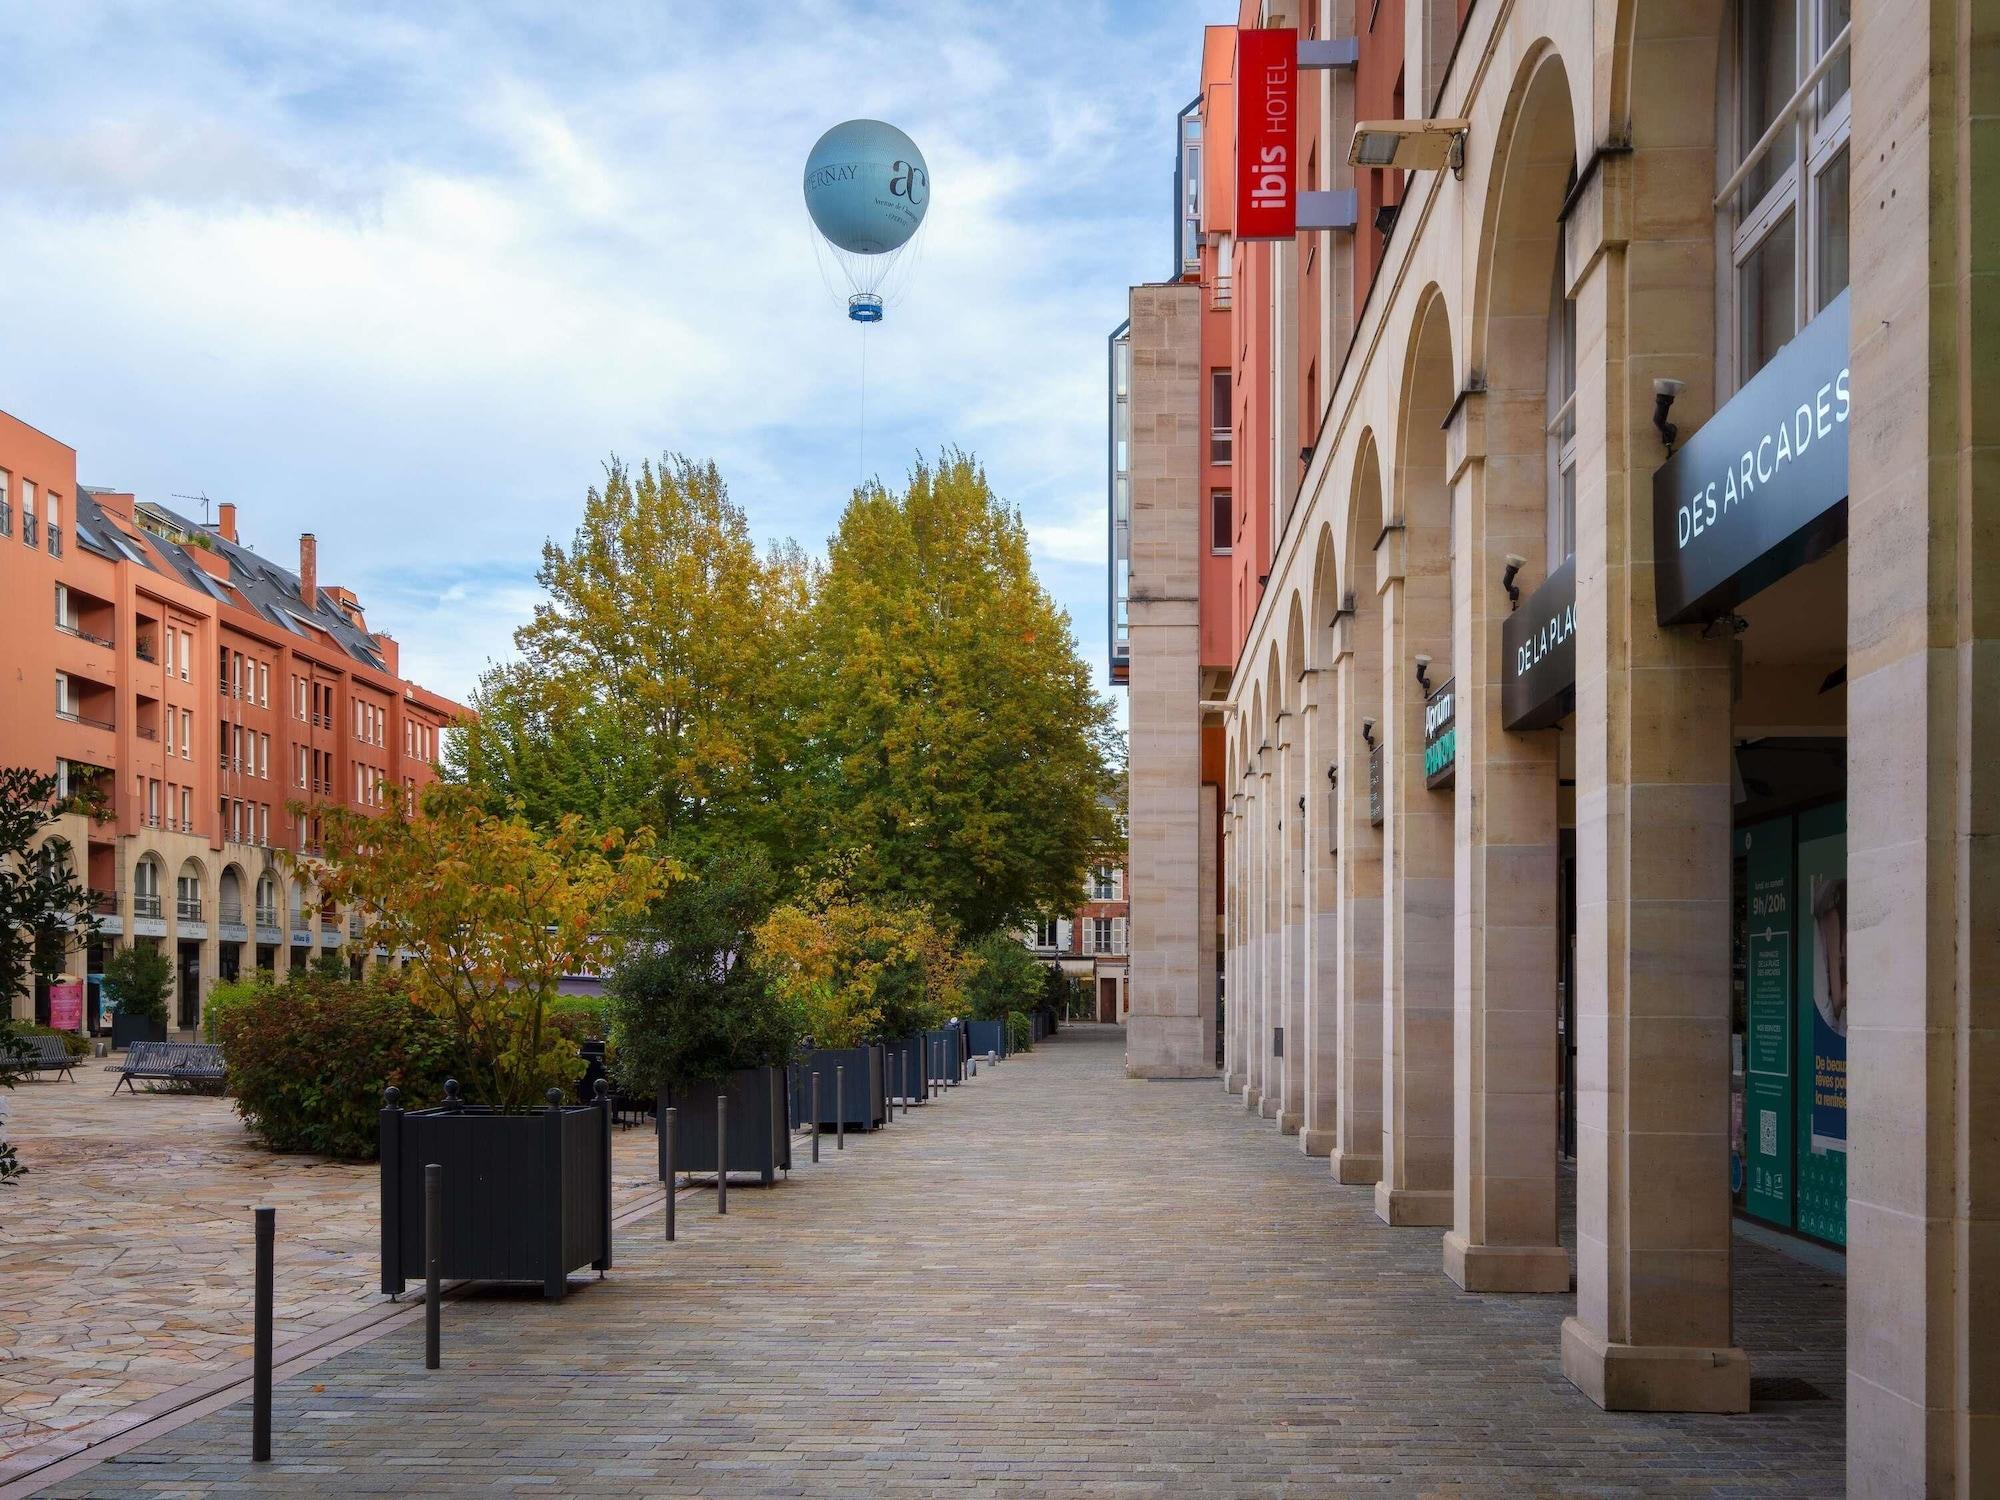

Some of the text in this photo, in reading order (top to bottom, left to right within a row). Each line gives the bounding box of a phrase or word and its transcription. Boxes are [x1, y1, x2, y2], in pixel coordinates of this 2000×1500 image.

[1251, 57, 1288, 208] ibis HOTEL
[1678, 368, 1849, 549] DES ARCADES
[1517, 638, 1531, 677] DE
[1533, 626, 1547, 664] LA
[1753, 892, 1786, 917] 9h/20h
[1815, 1055, 1846, 1072] De beau
[1815, 1070, 1846, 1092] rêves po
[1815, 1090, 1823, 1105] la
